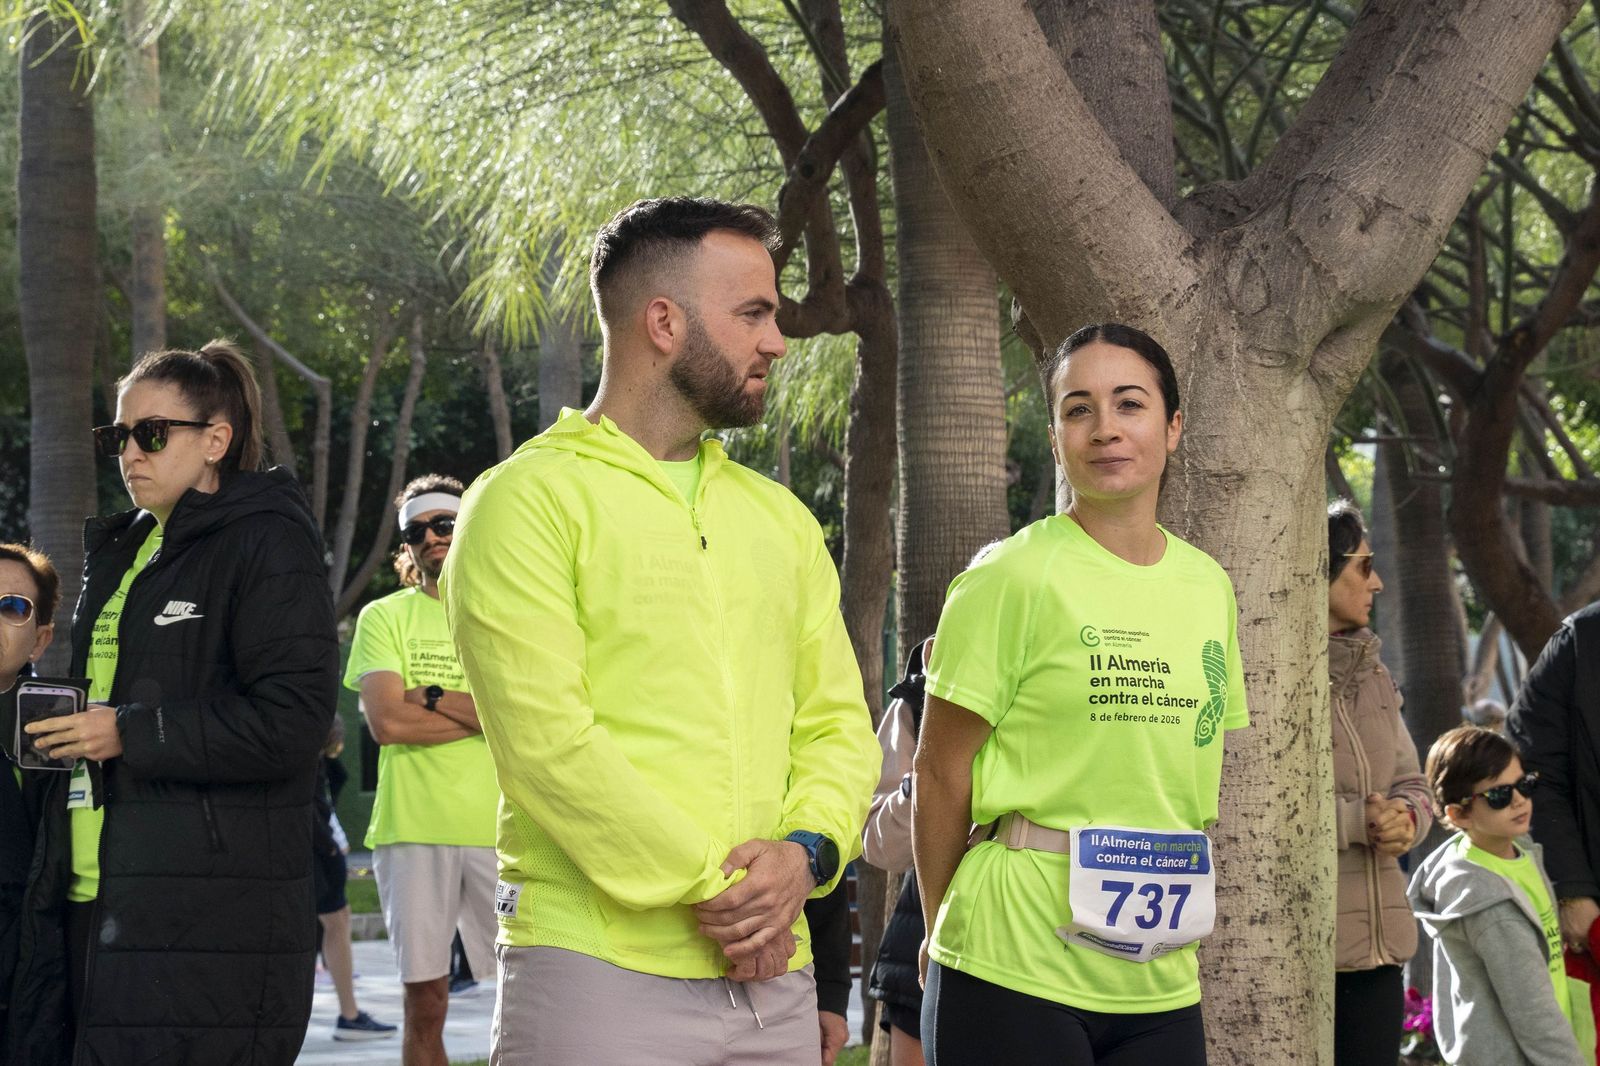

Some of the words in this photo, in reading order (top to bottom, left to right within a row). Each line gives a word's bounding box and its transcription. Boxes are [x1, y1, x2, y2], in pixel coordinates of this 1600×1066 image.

[162, 601, 197, 616] NIKE
[1090, 654, 1102, 671] II
[1107, 655, 1171, 674] Almería
[1090, 676, 1111, 687] en
[1116, 675, 1165, 689] marcha
[1089, 691, 1139, 705] contra
[1141, 692, 1154, 705] el
[1156, 693, 1199, 708] cáncer
[1090, 712, 1097, 722] 8
[1100, 713, 1112, 722] de
[1114, 712, 1147, 722] febrero
[1149, 714, 1159, 722] de
[1161, 715, 1181, 724] 2026
[1091, 834, 1099, 846] II
[1101, 835, 1151, 851] Almería
[1154, 842, 1167, 851] en
[1169, 840, 1202, 851] marcha
[1096, 853, 1137, 865] contra
[1140, 855, 1153, 866] el
[1155, 856, 1188, 868] cáncer
[1101, 879, 1192, 930] 737
